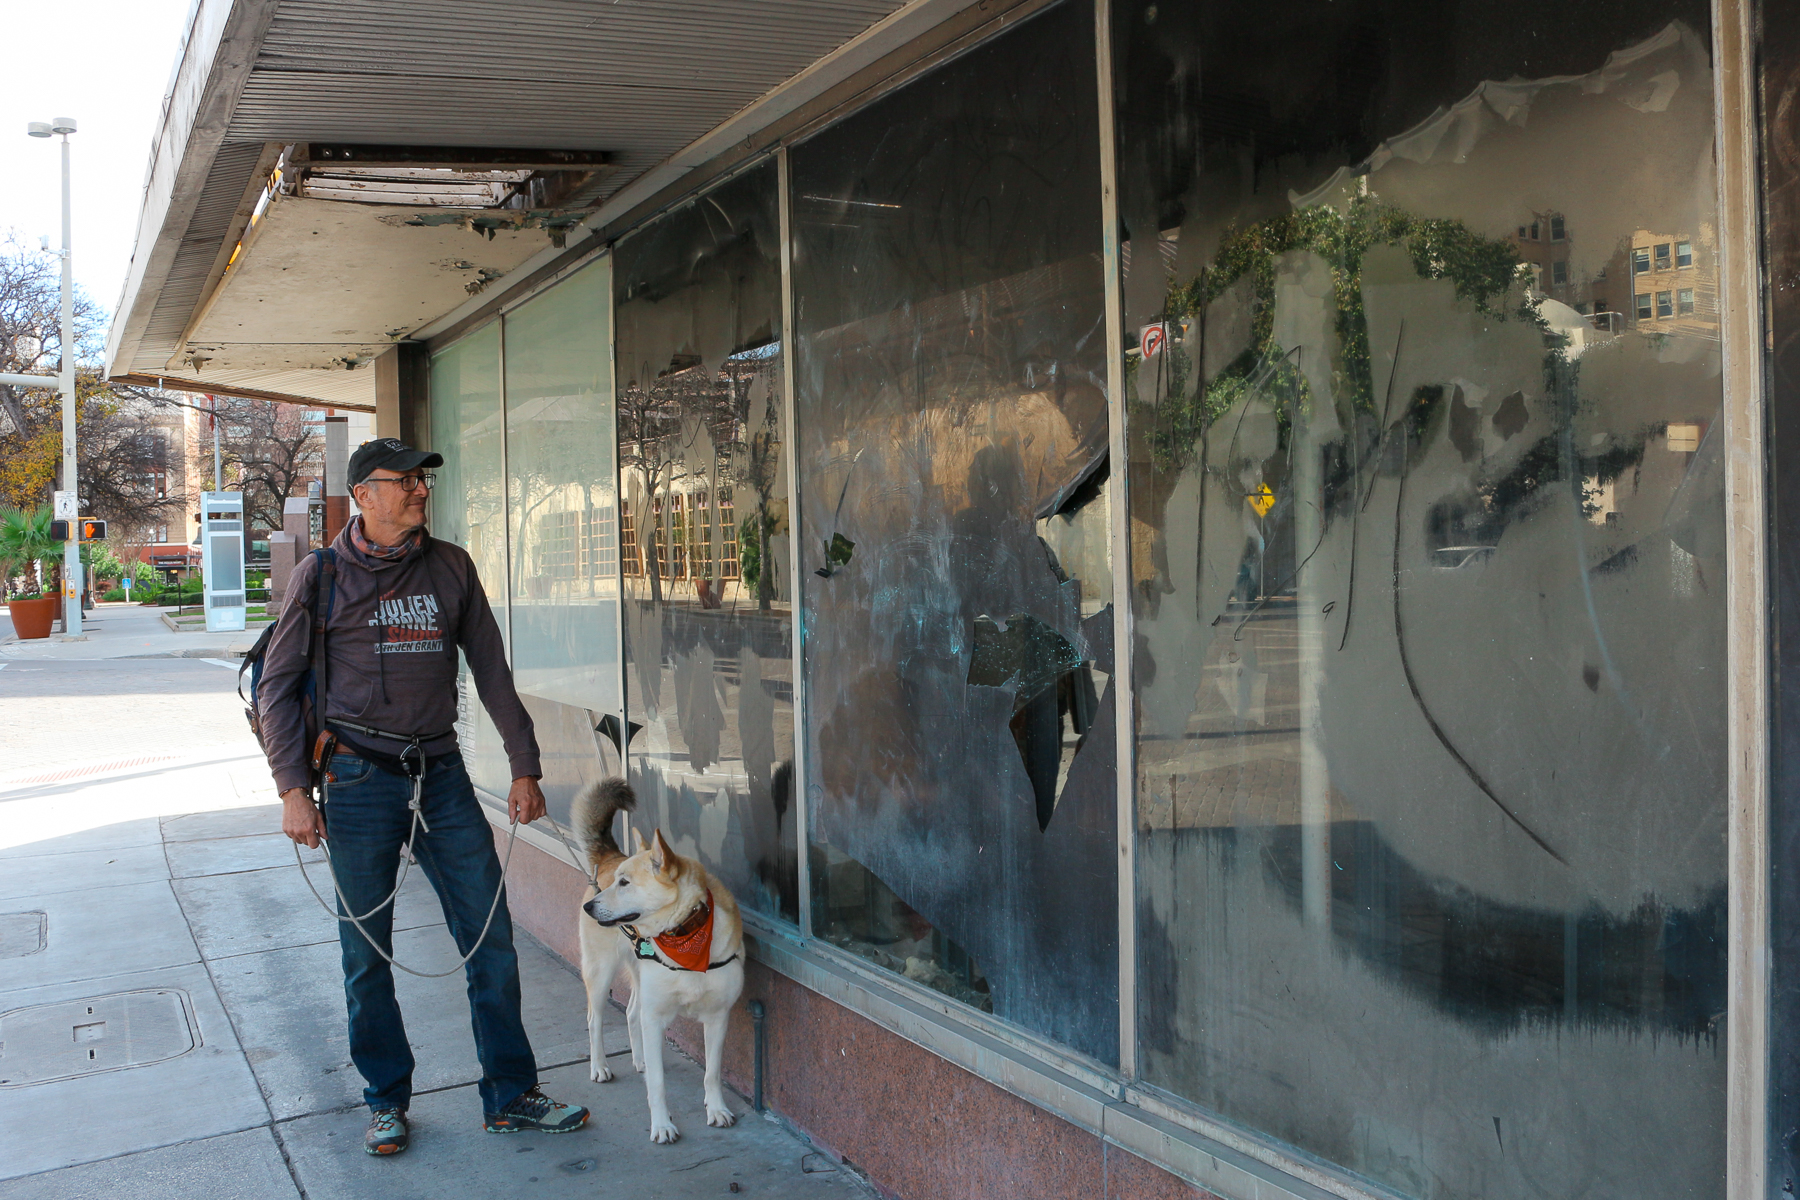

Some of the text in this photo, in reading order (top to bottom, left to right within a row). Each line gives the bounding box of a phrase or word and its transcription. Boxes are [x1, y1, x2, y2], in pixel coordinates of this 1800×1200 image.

[374, 594, 439, 620] JULIEN
[387, 626, 443, 643] SHOW
[374, 641, 443, 652] WTH JEN GRANT
